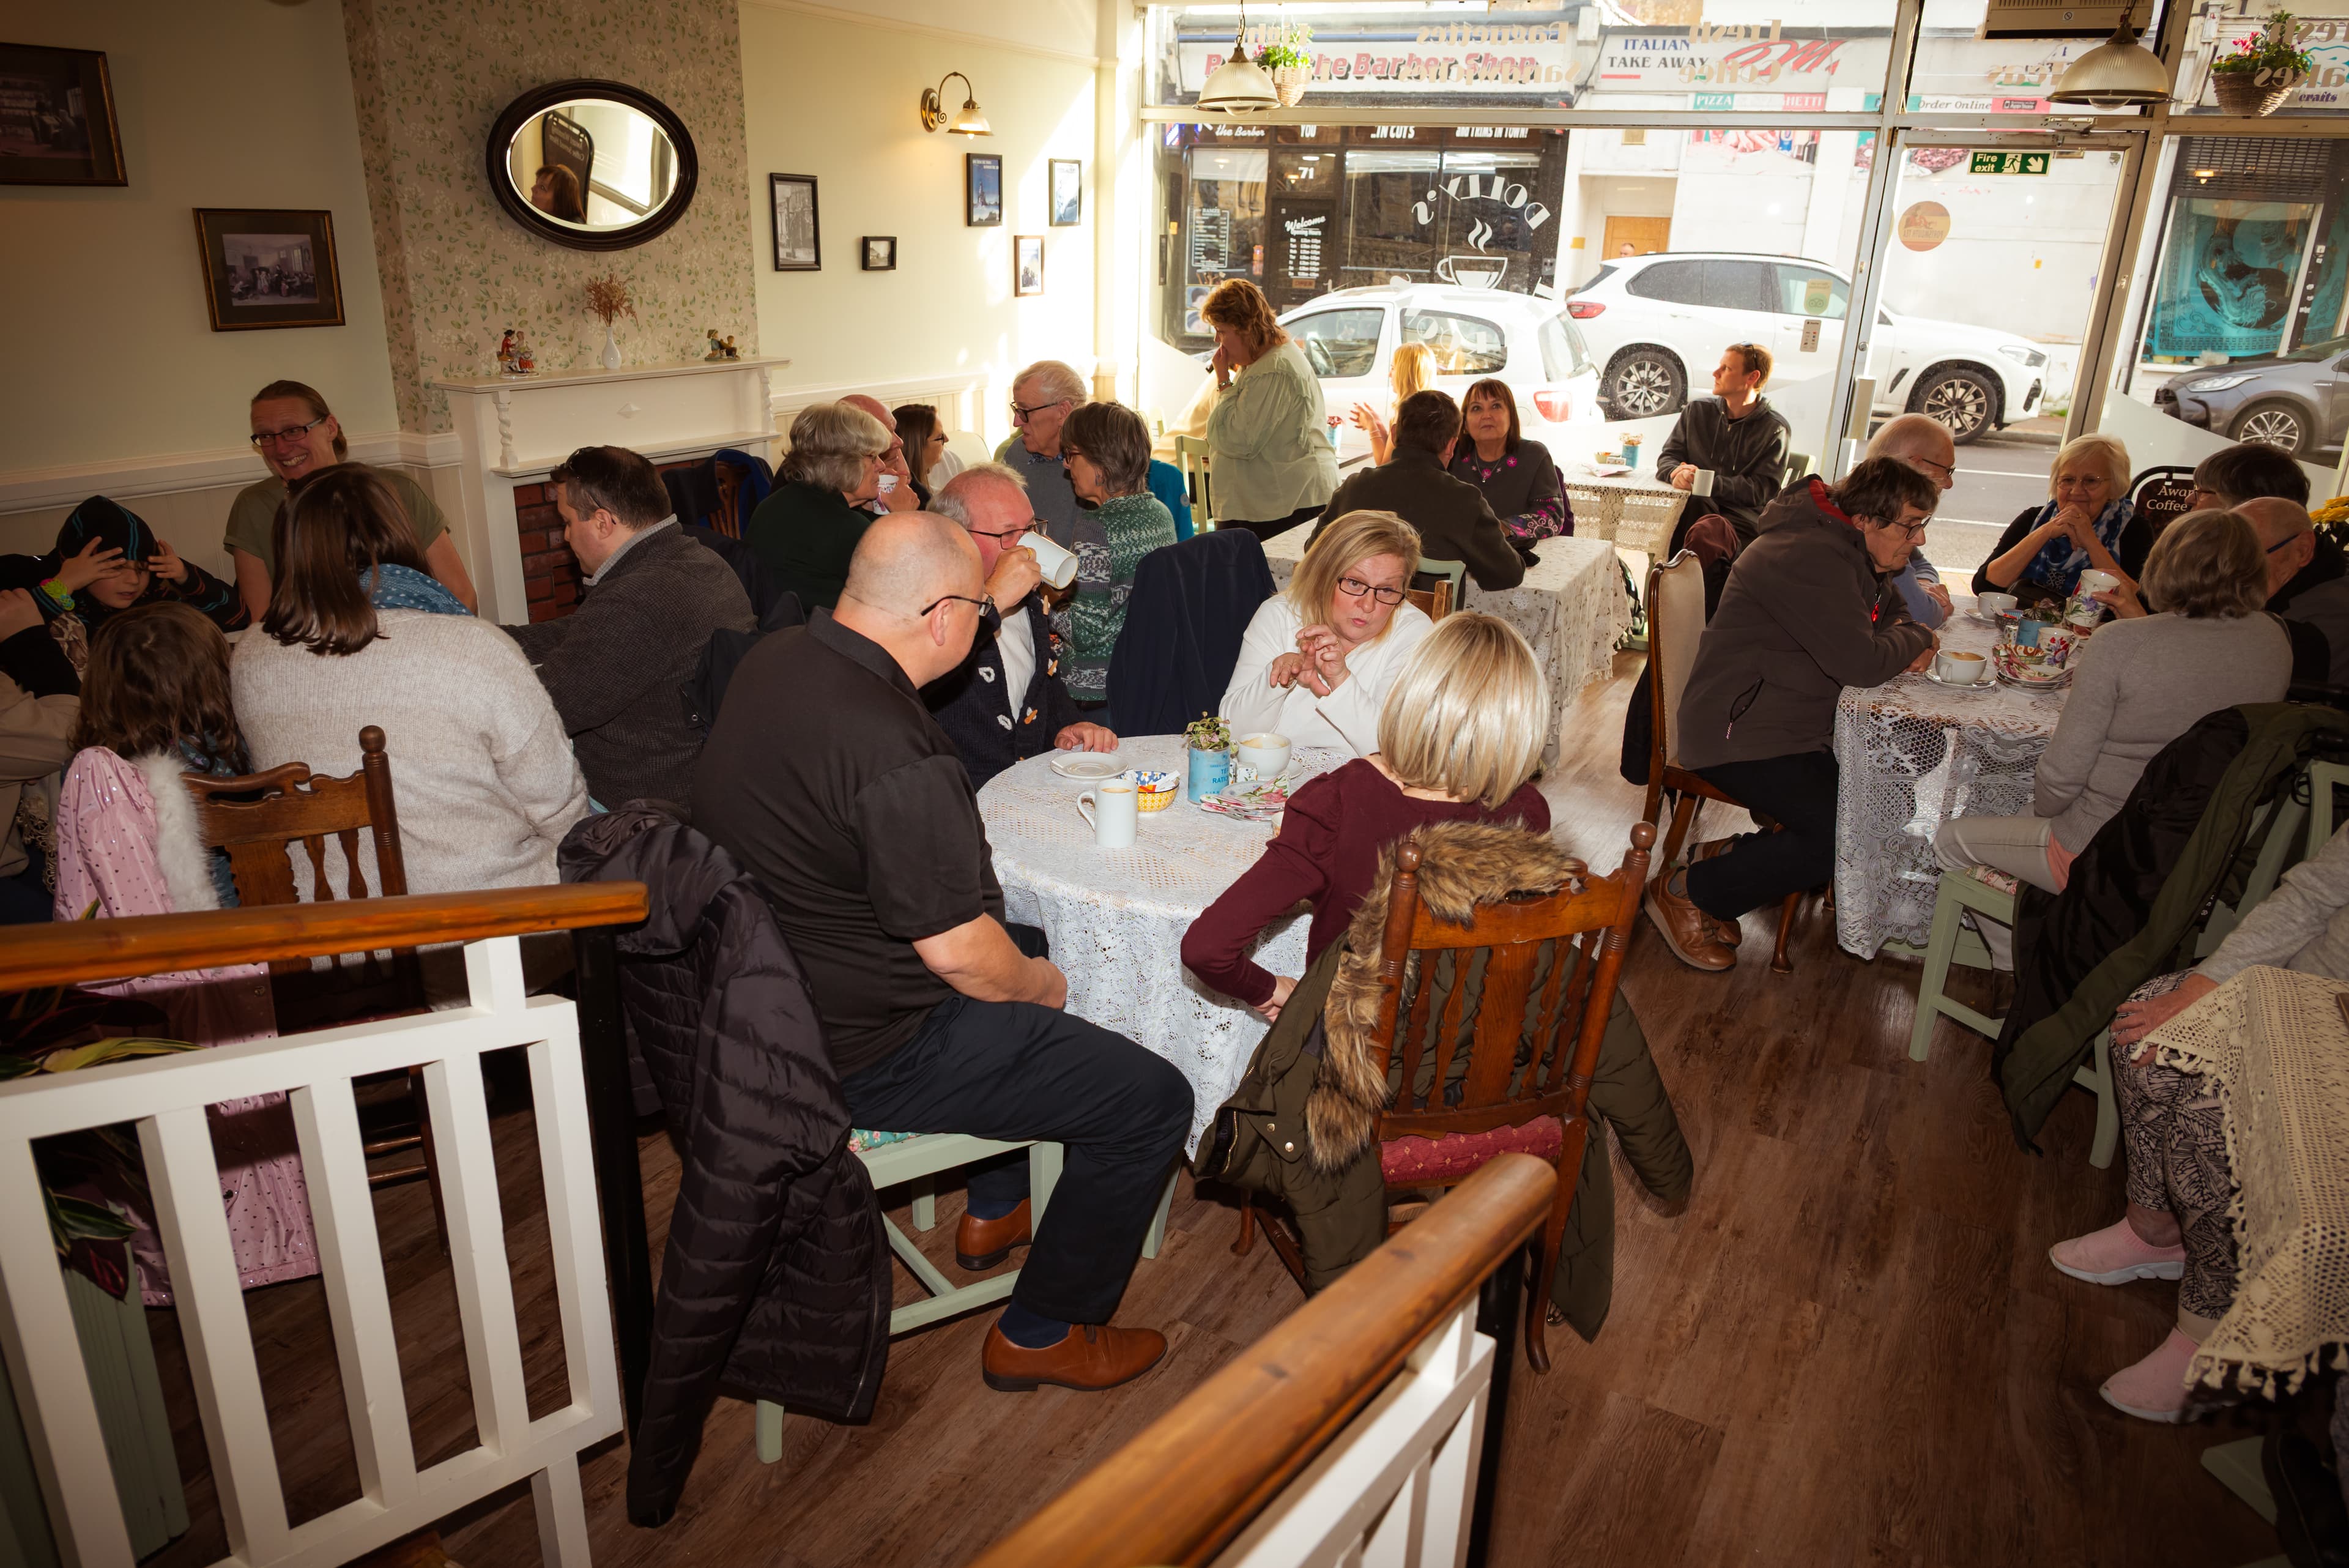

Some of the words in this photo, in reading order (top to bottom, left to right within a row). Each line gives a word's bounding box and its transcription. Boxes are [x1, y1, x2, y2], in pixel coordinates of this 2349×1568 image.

[1624, 39, 1690, 50] ITALIAN
[1352, 52, 1457, 78] Barber
[1464, 51, 1537, 80] Shop
[1608, 56, 1651, 68] TAKE
[1657, 57, 1709, 69] AWAY
[1696, 95, 1732, 106] PIZZA
[1918, 99, 1951, 109] Order
[1954, 100, 1992, 110] Online
[1215, 124, 1233, 136] the
[1234, 126, 1266, 137] Barber
[1300, 125, 1316, 138] YOU
[1389, 125, 1416, 139] CUTS
[1976, 154, 1998, 162] Fire
[1297, 166, 1315, 179] 71
[1974, 163, 1995, 173] exit
[1285, 216, 1326, 232] Welcome
[2146, 499, 2188, 511] Coffee
